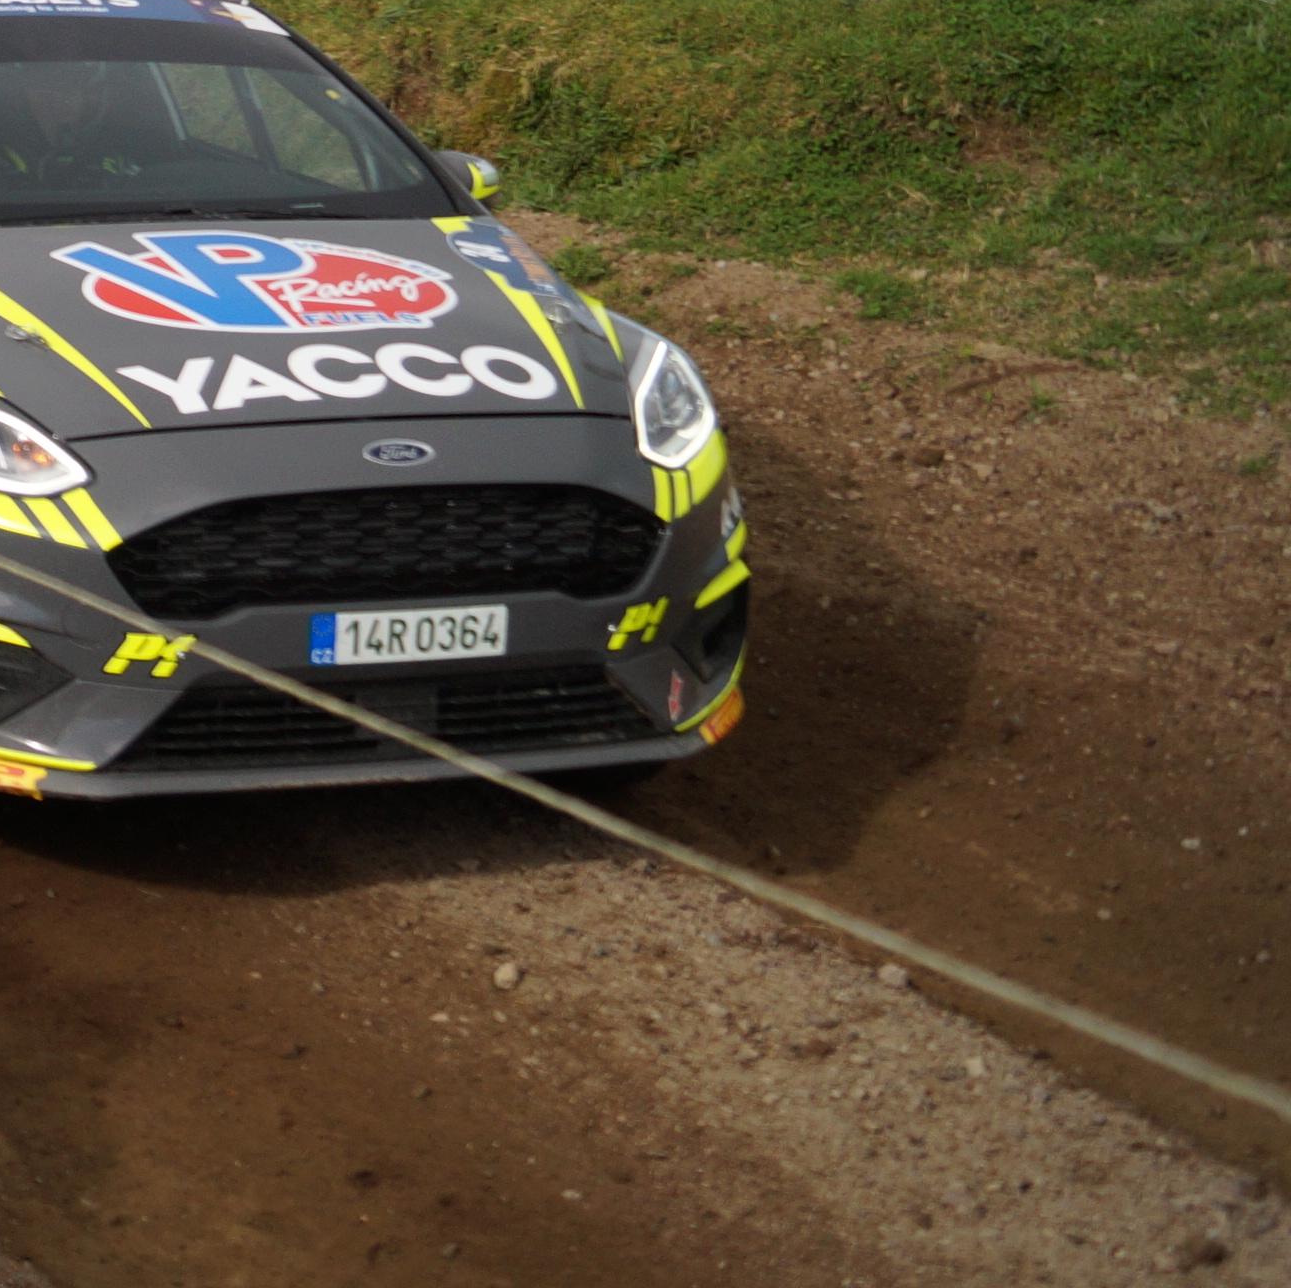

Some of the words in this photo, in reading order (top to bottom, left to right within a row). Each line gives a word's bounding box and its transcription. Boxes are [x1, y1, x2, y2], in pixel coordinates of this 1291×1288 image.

[269, 271, 425, 312] Racing
[303, 311, 422, 327] FUELS
[116, 343, 558, 414] YACCO
[345, 618, 408, 657] 14R
[416, 613, 500, 653] 0364
